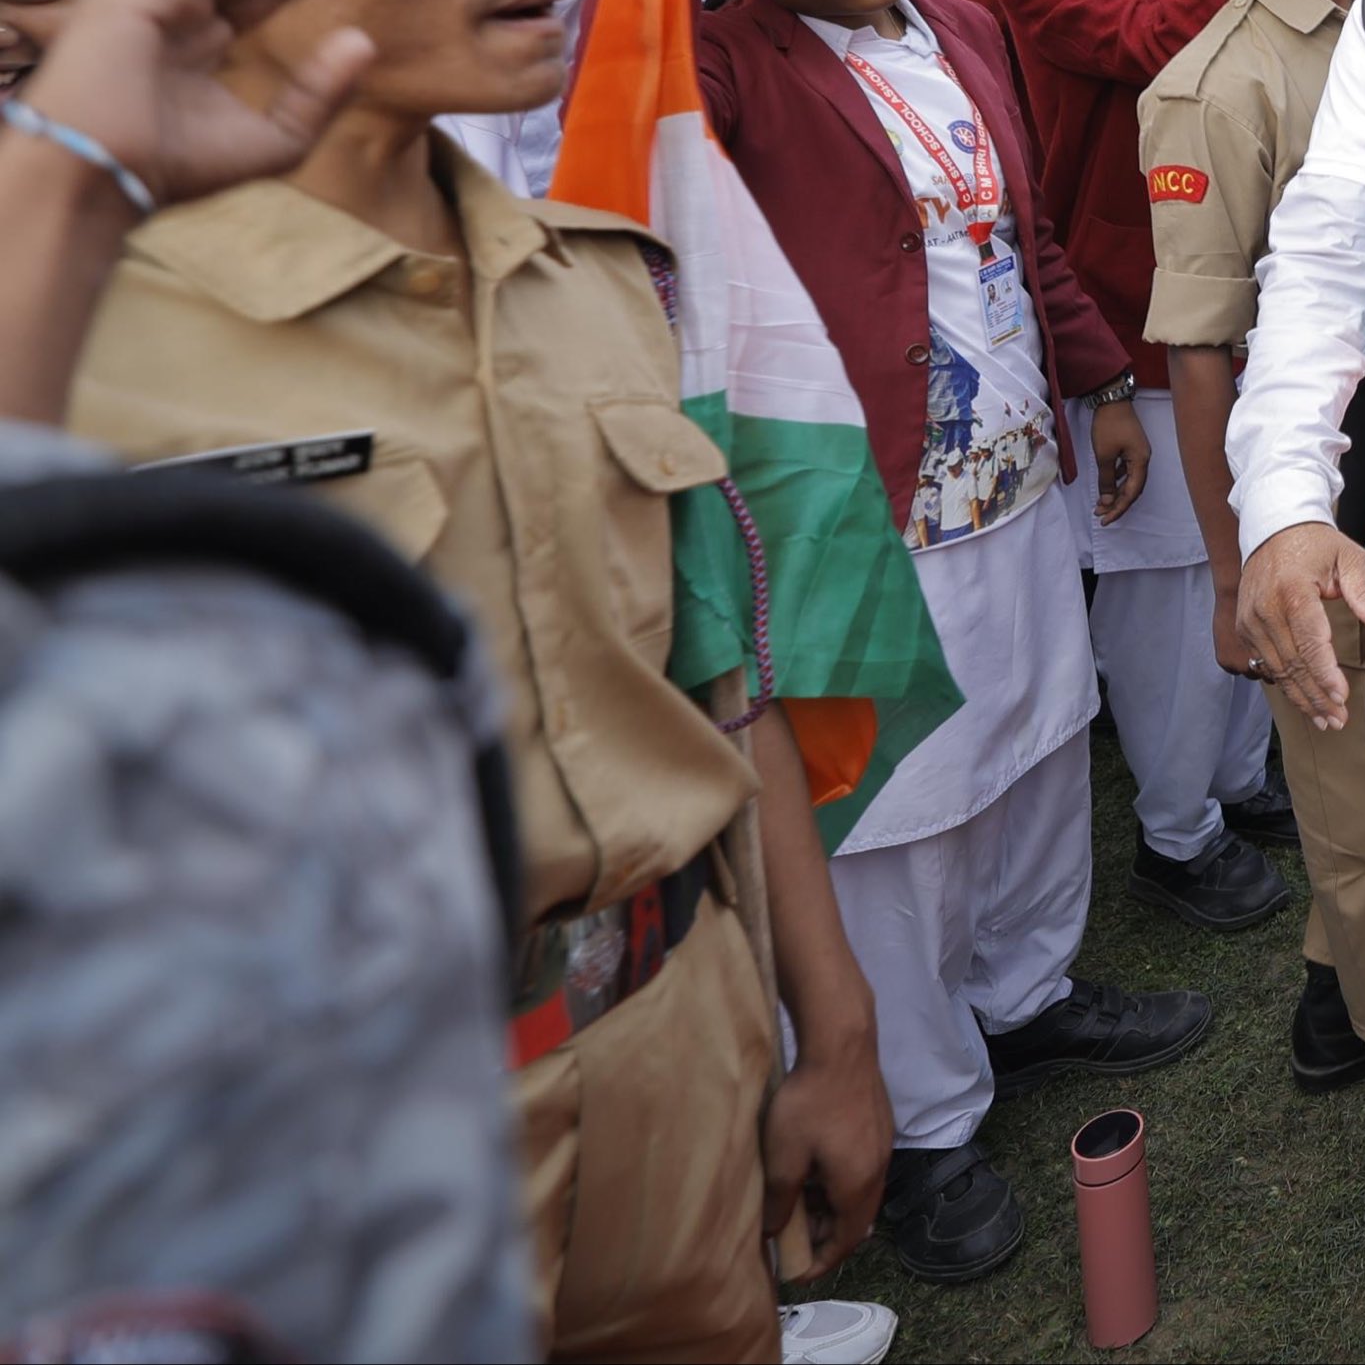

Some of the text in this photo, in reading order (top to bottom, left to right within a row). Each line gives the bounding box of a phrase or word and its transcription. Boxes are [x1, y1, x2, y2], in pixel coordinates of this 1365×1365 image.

[862, 65, 902, 104] ASHOK
[900, 102, 940, 151] SCHOOL
[937, 151, 960, 180] SHRI
[1153, 170, 1195, 194] NCC
